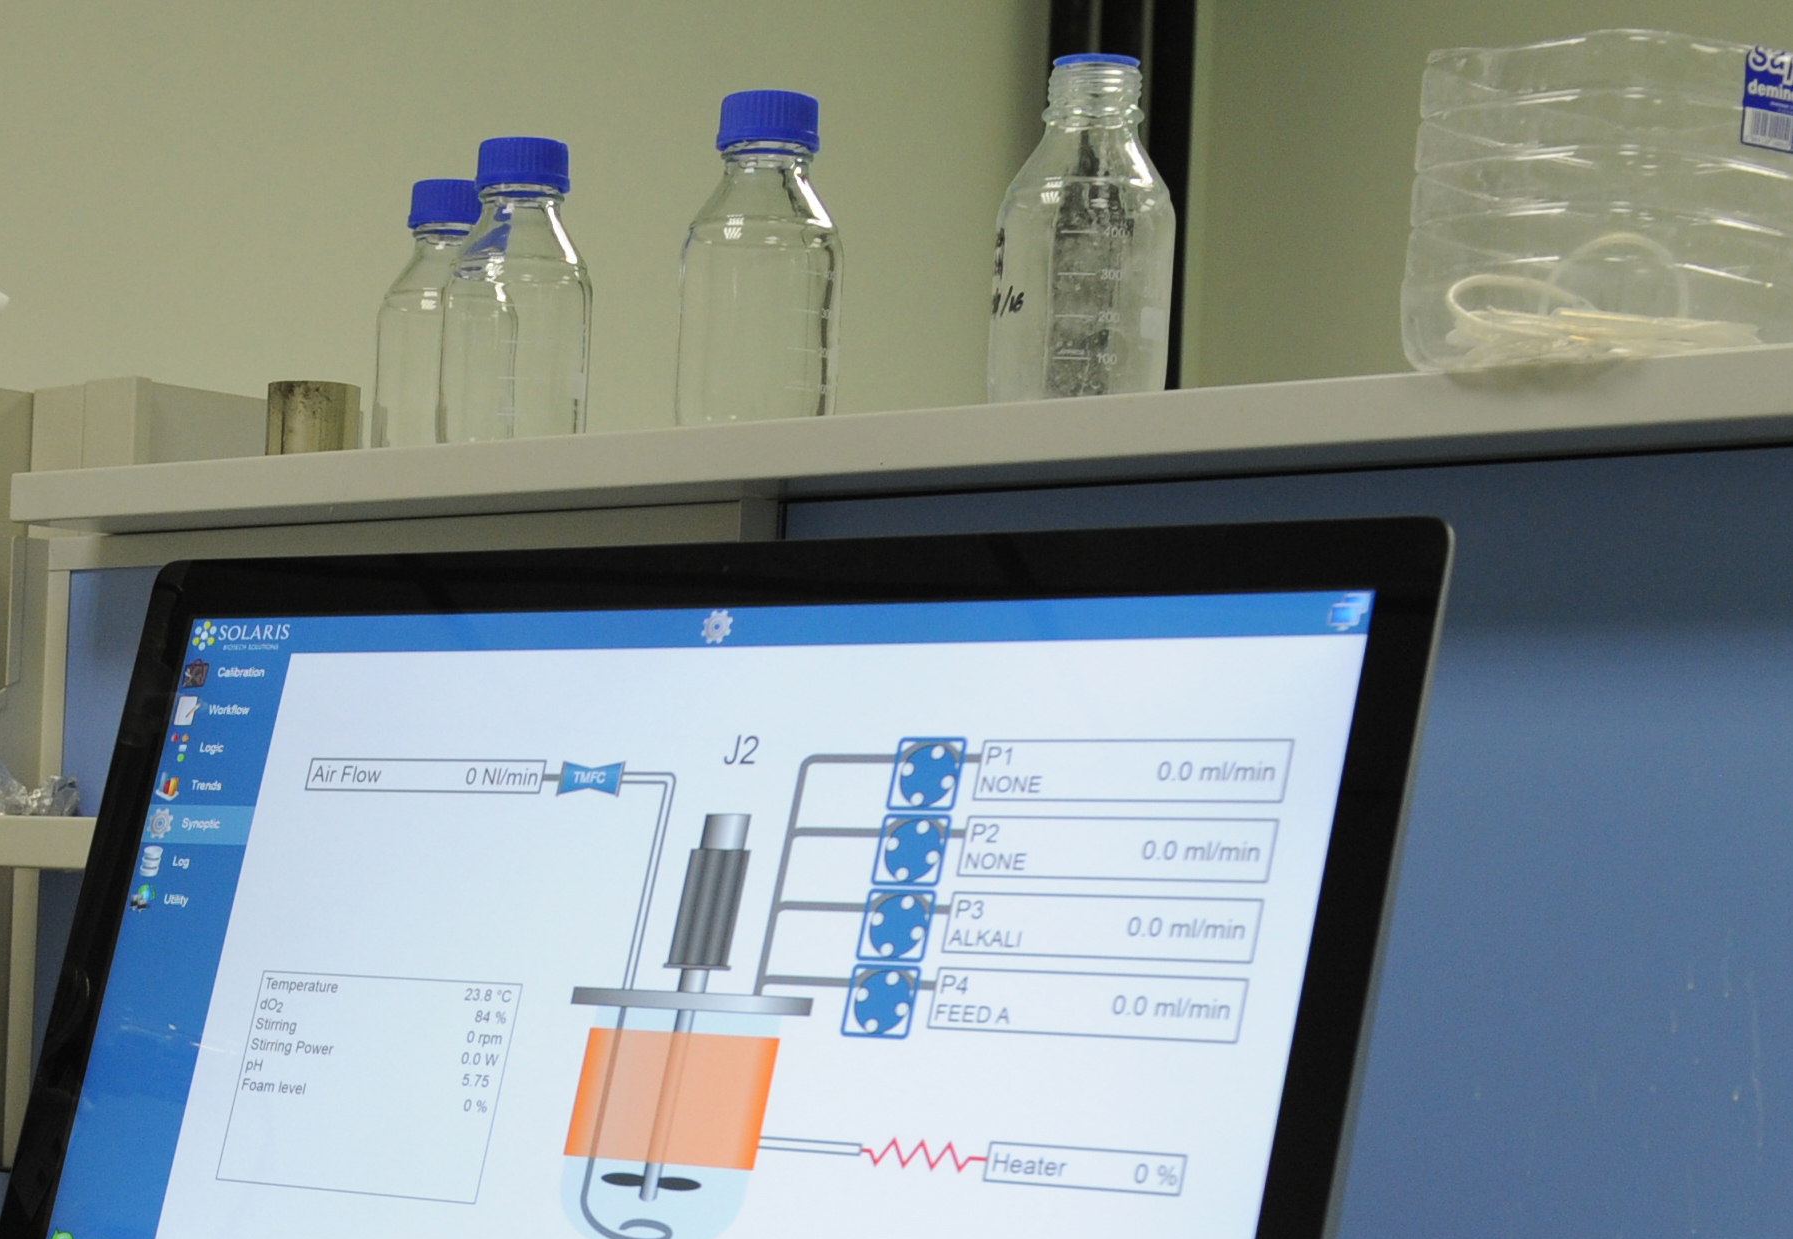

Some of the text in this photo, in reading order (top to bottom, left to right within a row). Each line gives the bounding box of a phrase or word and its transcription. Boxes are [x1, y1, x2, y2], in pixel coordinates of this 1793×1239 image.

[1100, 270, 1123, 281] 300
[1098, 312, 1120, 323] 200
[1096, 353, 1118, 365] 100
[217, 623, 291, 641] SOLARIS
[217, 666, 265, 679] Calibration
[208, 703, 250, 716] Workflow
[199, 741, 224, 756] Logic
[724, 736, 759, 766] J2
[985, 746, 1014, 766] P1
[312, 766, 382, 784] Air Flow
[465, 768, 477, 785] 0
[572, 772, 606, 784] TMFC
[1156, 761, 1276, 784] 0.0 ml/min
[191, 780, 222, 792] Trends
[979, 776, 1041, 794] NONE
[181, 816, 220, 832] Synoptic
[969, 824, 999, 844] P2
[1141, 840, 1261, 864] 0.0 ml/min
[172, 856, 190, 870] Log
[964, 853, 1026, 872] NONE
[163, 892, 189, 908] Utility
[955, 899, 984, 920] P3
[1126, 917, 1246, 942] 0.0 ml/min
[949, 930, 1022, 949] ALKALI
[265, 977, 338, 996] Temperature
[939, 976, 969, 996] P4
[464, 989, 491, 1002] 23.8
[934, 1005, 1010, 1024] FEED A
[1111, 995, 1231, 1022] 0.0 ml/min
[255, 1018, 297, 1034] Stirring
[475, 1011, 507, 1025] 84 %
[250, 1038, 334, 1056] Stirring Power
[466, 1031, 503, 1048] 0 rpm
[245, 1058, 263, 1073] pH
[461, 1052, 499, 1066] 0.0 W
[241, 1079, 307, 1095] Foam level
[462, 1074, 490, 1088] 5.75
[463, 1099, 488, 1114] 0 %
[992, 1152, 1067, 1178] Heater
[1133, 1163, 1178, 1187] 0 %
